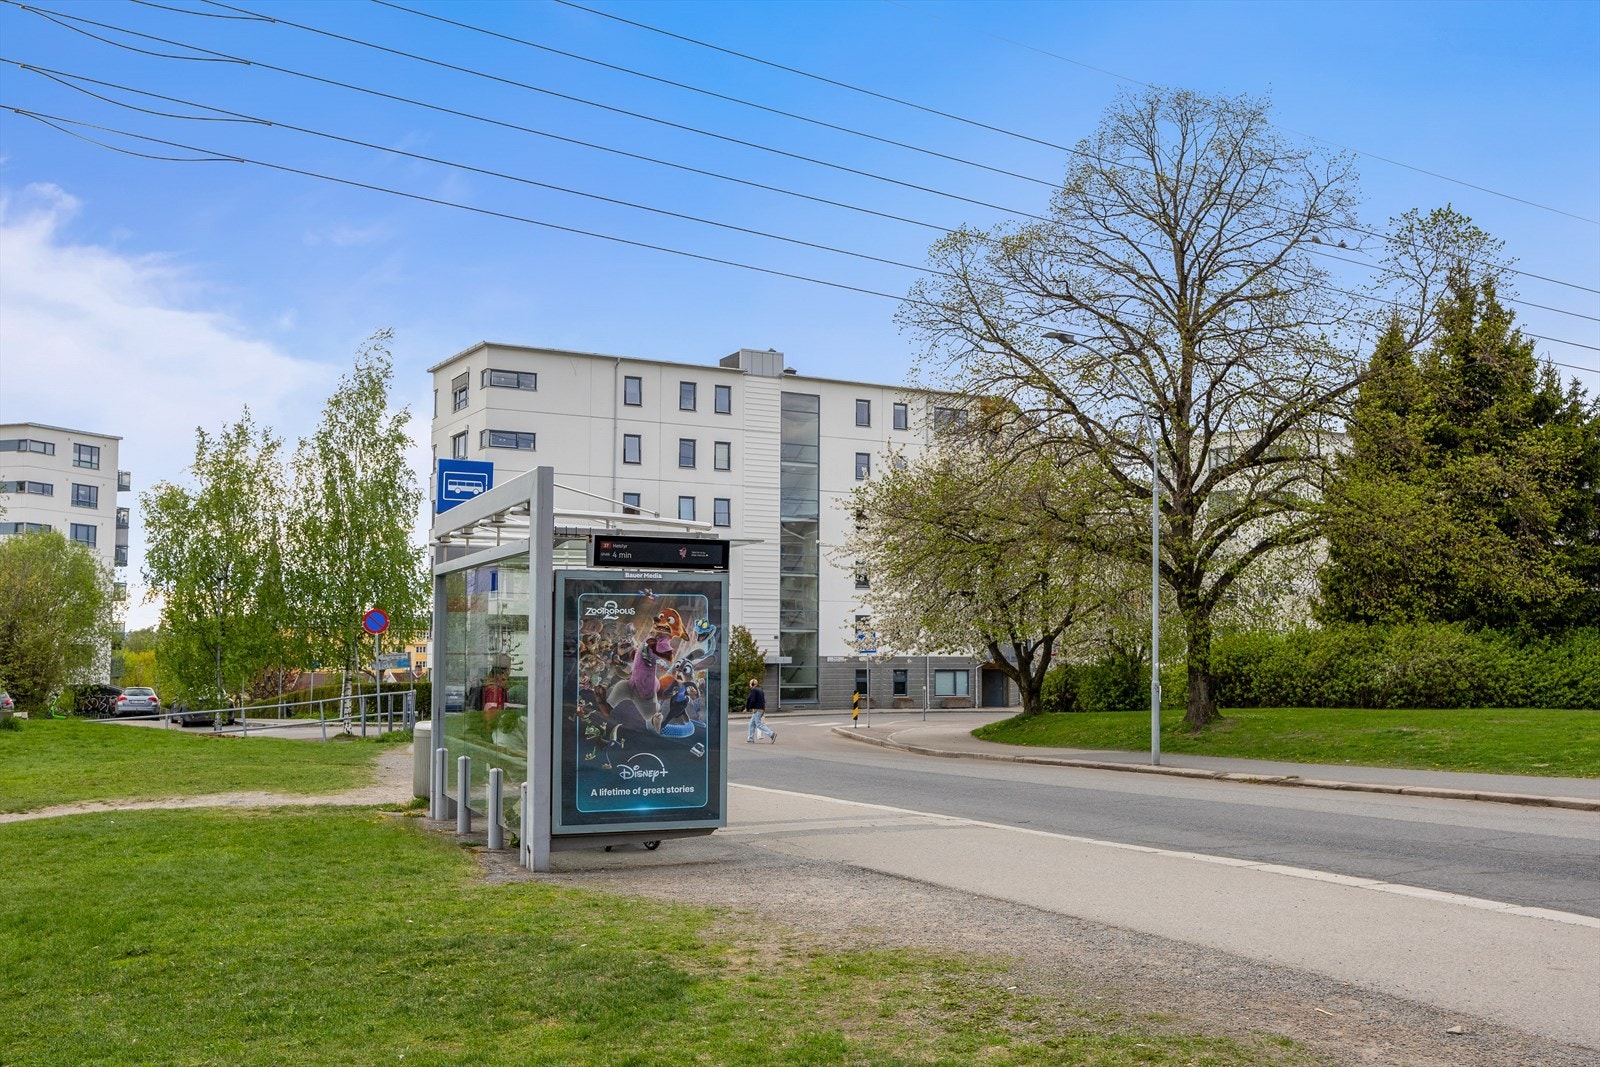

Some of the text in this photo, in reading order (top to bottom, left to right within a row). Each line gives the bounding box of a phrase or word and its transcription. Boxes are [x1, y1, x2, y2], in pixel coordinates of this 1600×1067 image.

[585, 607, 636, 616] ZOOTROPOLIS
[590, 785, 695, 797] A lifetime of great stories
